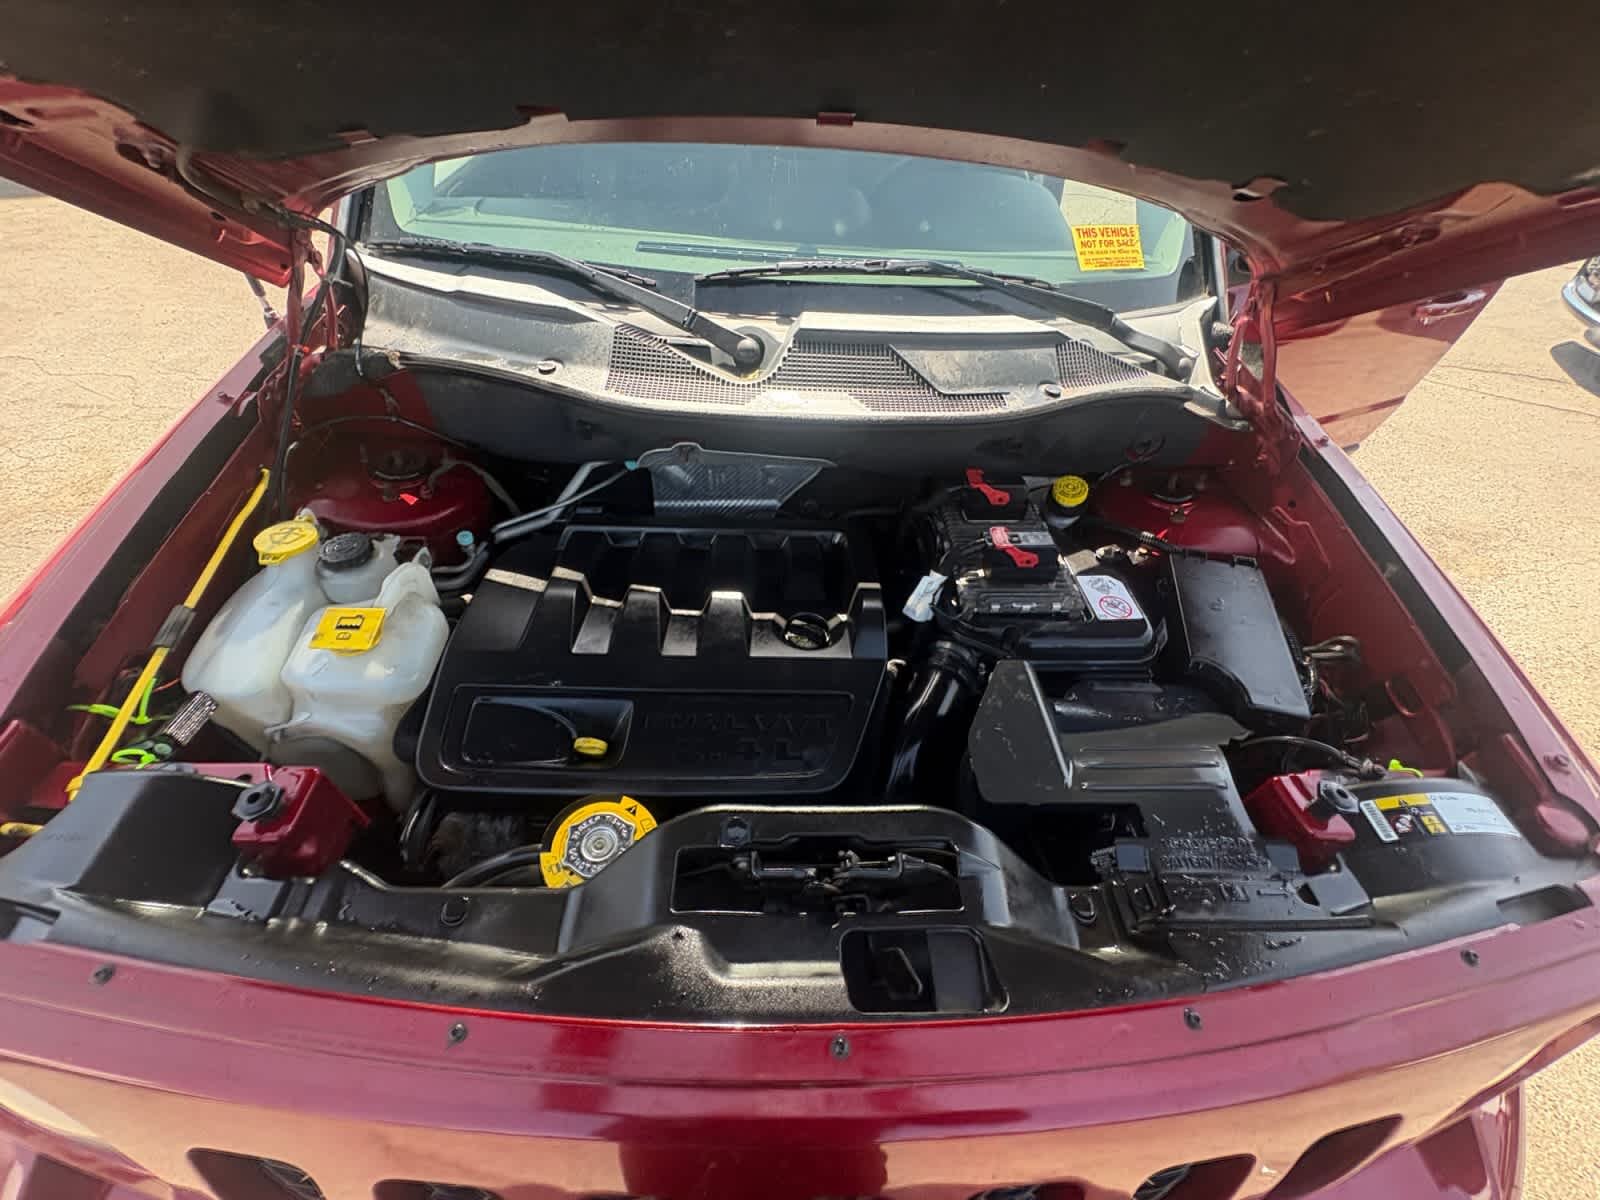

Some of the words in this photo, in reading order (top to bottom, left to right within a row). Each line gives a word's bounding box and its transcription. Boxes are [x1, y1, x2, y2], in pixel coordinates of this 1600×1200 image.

[1075, 227, 1098, 239] THIS
[1098, 226, 1135, 238] VEHICLE
[1080, 239, 1097, 249] NOT
[1098, 239, 1115, 248] FOR
